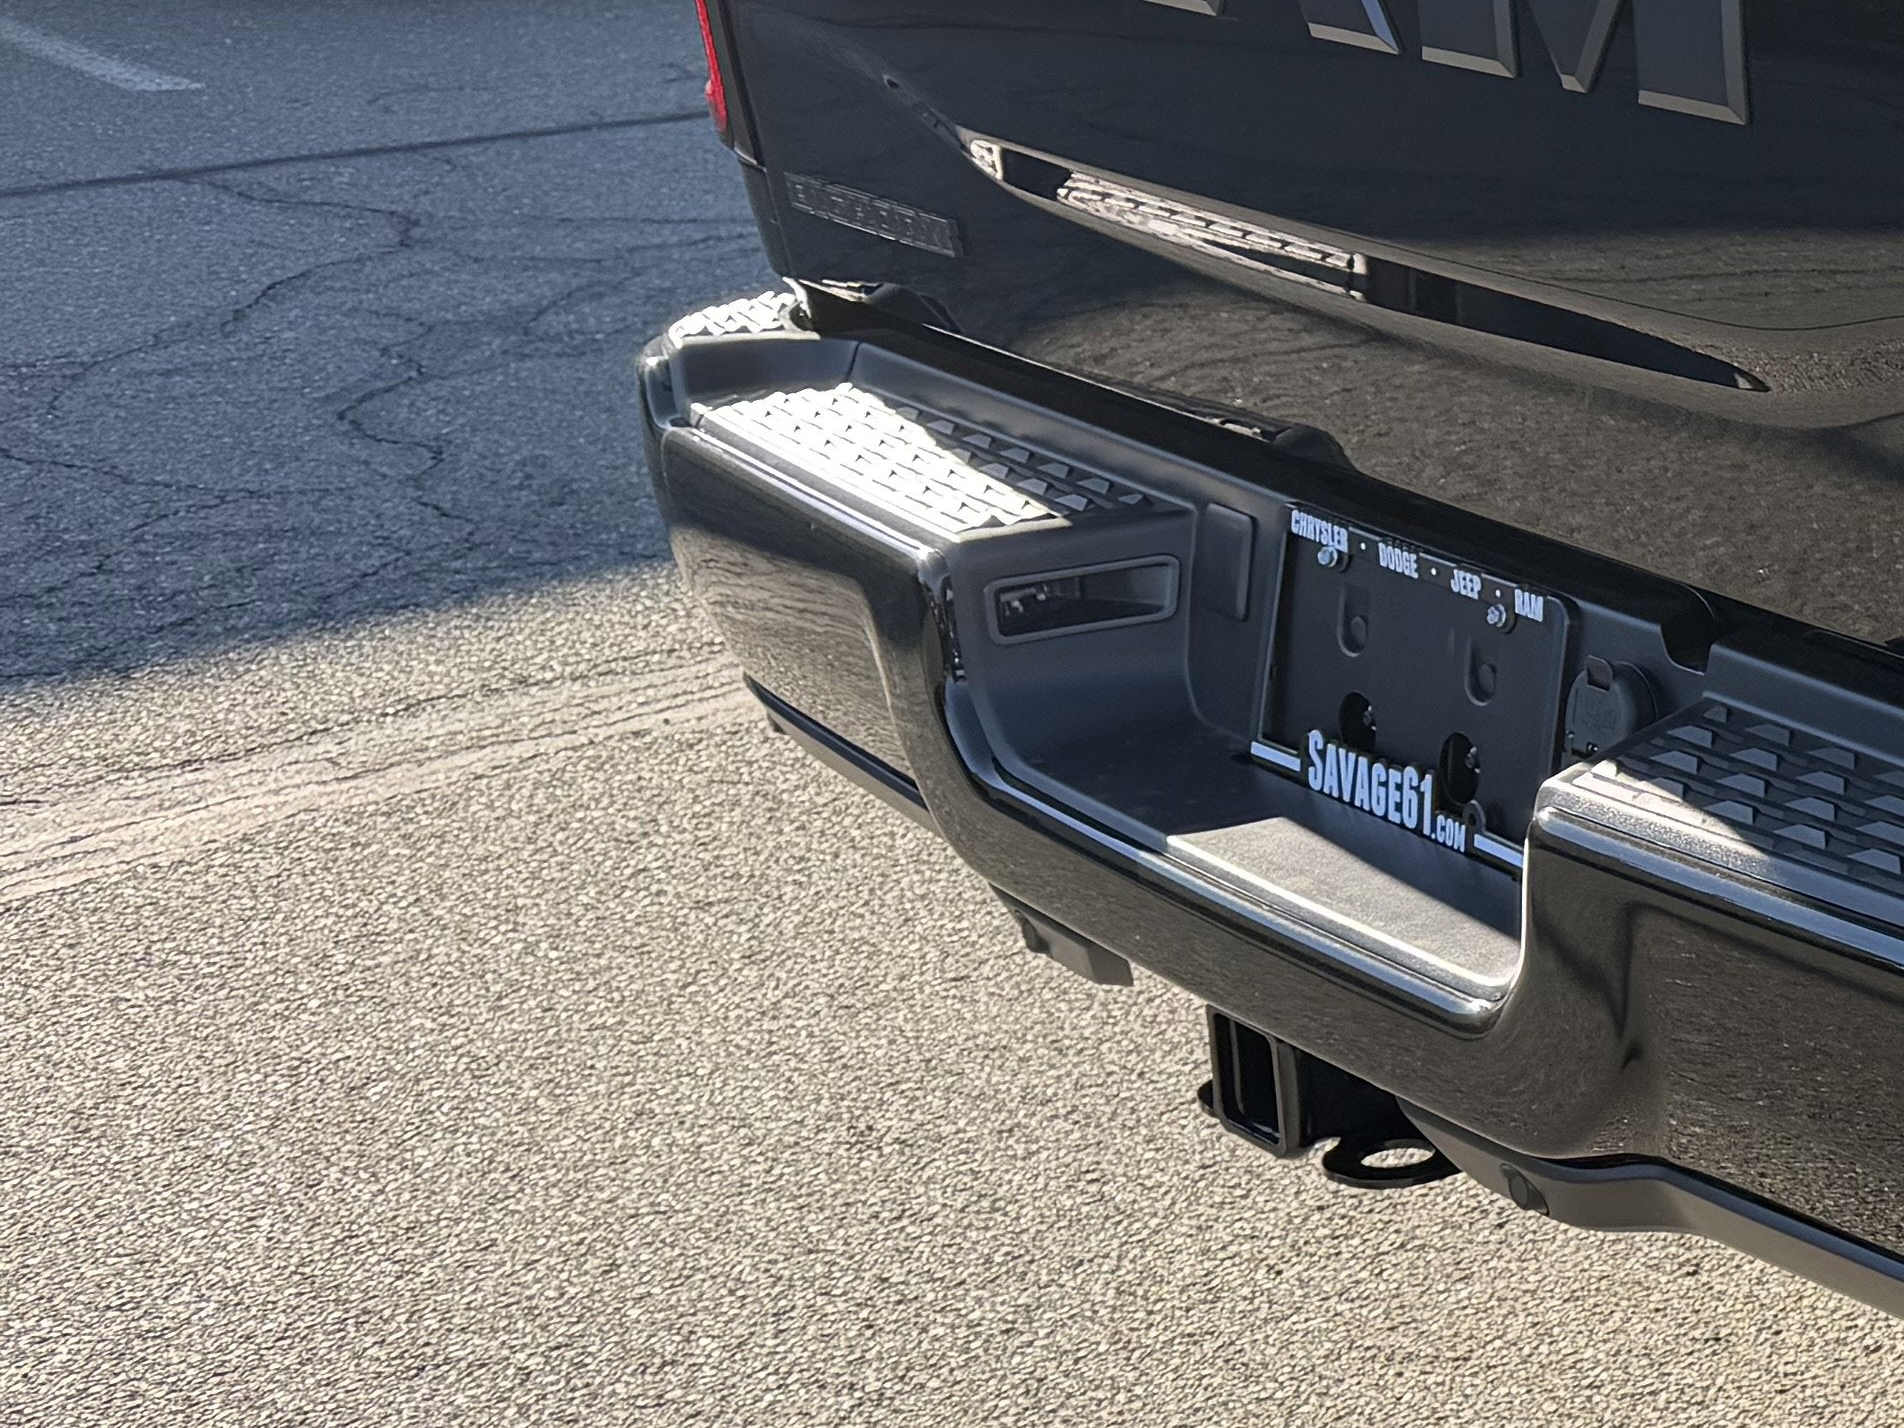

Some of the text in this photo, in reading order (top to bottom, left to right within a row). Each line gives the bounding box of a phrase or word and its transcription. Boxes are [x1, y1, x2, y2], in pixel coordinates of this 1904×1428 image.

[1290, 509, 1545, 622] CHRYSLER DODGE JEEP RAM
